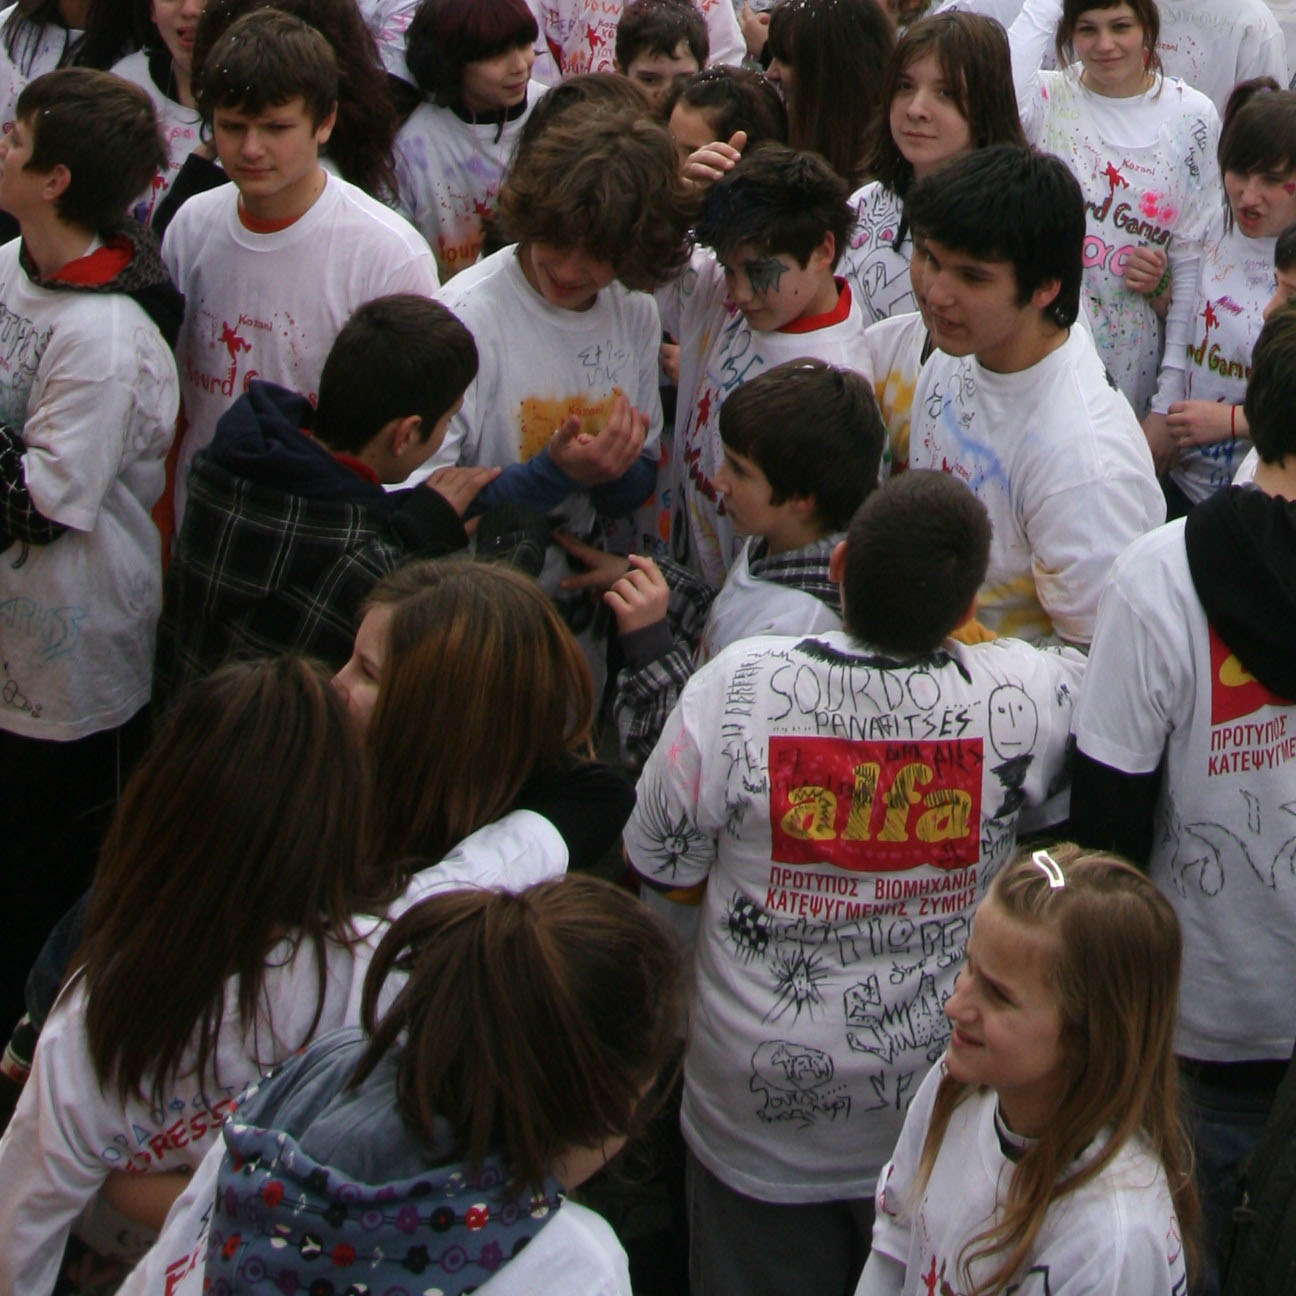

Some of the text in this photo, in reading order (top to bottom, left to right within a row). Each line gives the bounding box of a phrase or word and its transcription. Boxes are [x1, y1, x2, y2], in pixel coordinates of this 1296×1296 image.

[1120, 158, 1156, 177] Kozani
[1113, 202, 1172, 246] Games
[238, 312, 274, 333] Kozani
[1211, 715, 1287, 751] ΠΡΟΤΥΠΟΣ
[780, 761, 973, 843] alfa
[770, 866, 978, 901] ΠΡΟΤΥΠΟΣ ΒΙΟΜΗΧΑΝΙΑ
[764, 887, 977, 922] ΚΑΤΕΨΥΓΜΕΝΗΣ ΖΥΜΗΣ
